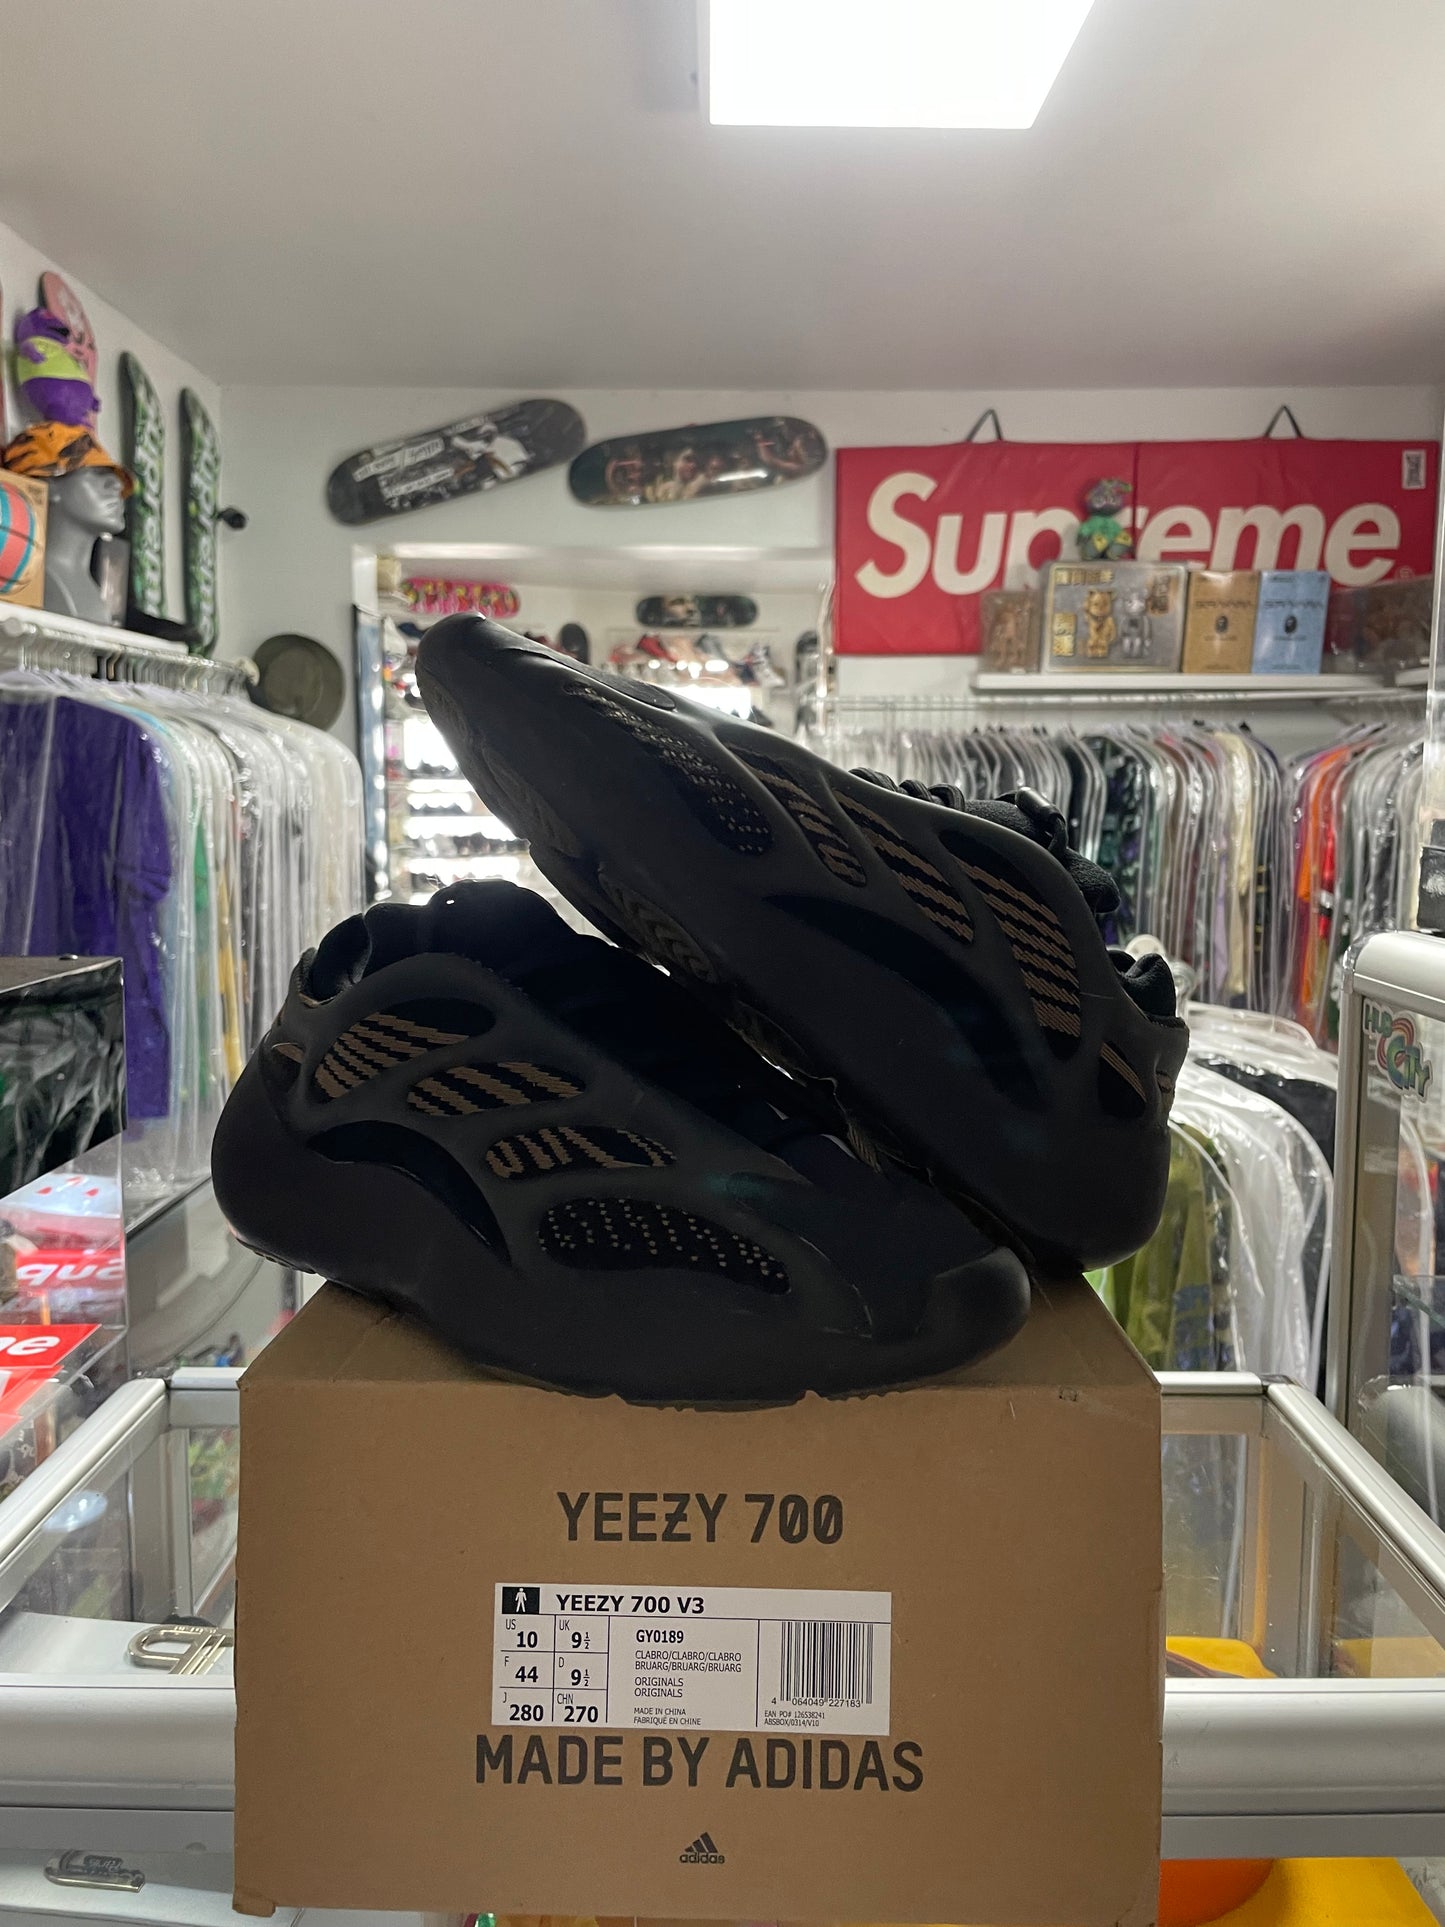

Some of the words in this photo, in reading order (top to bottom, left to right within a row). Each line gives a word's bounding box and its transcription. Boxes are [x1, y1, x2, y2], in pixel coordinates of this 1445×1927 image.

[854, 471, 1401, 599] Supeme
[556, 1491, 728, 1543] YEEZY
[744, 1493, 844, 1545] 700
[556, 1594, 625, 1612] YEEZY
[630, 1595, 670, 1614] 700
[676, 1597, 705, 1615] V3
[505, 1618, 517, 1630] US
[559, 1619, 570, 1631] UK
[516, 1631, 538, 1648] 10
[636, 1629, 684, 1644] GY0189
[504, 1656, 510, 1667] F
[635, 1650, 742, 1662] CLABRO/CLABRO/CLABRO
[558, 1657, 565, 1668] D
[635, 1661, 742, 1673] BRUARG/BRUARG/BRUARG
[515, 1666, 539, 1683] 44
[634, 1676, 684, 1687] ORIGINALS
[502, 1692, 508, 1703] J
[634, 1687, 683, 1698] ORIGINALS
[556, 1693, 574, 1705] CHN
[509, 1704, 544, 1722] 280
[563, 1705, 599, 1723] 270
[633, 1707, 653, 1715] MADE
[664, 1708, 686, 1716] CHINA
[764, 1710, 777, 1718] EAN
[668, 1717, 678, 1725] EN
[680, 1718, 701, 1726] CHINE
[475, 1734, 624, 1786] MADE
[642, 1736, 710, 1788] BY
[725, 1737, 924, 1793] ADIDAS
[679, 1852, 726, 1866] adidas
